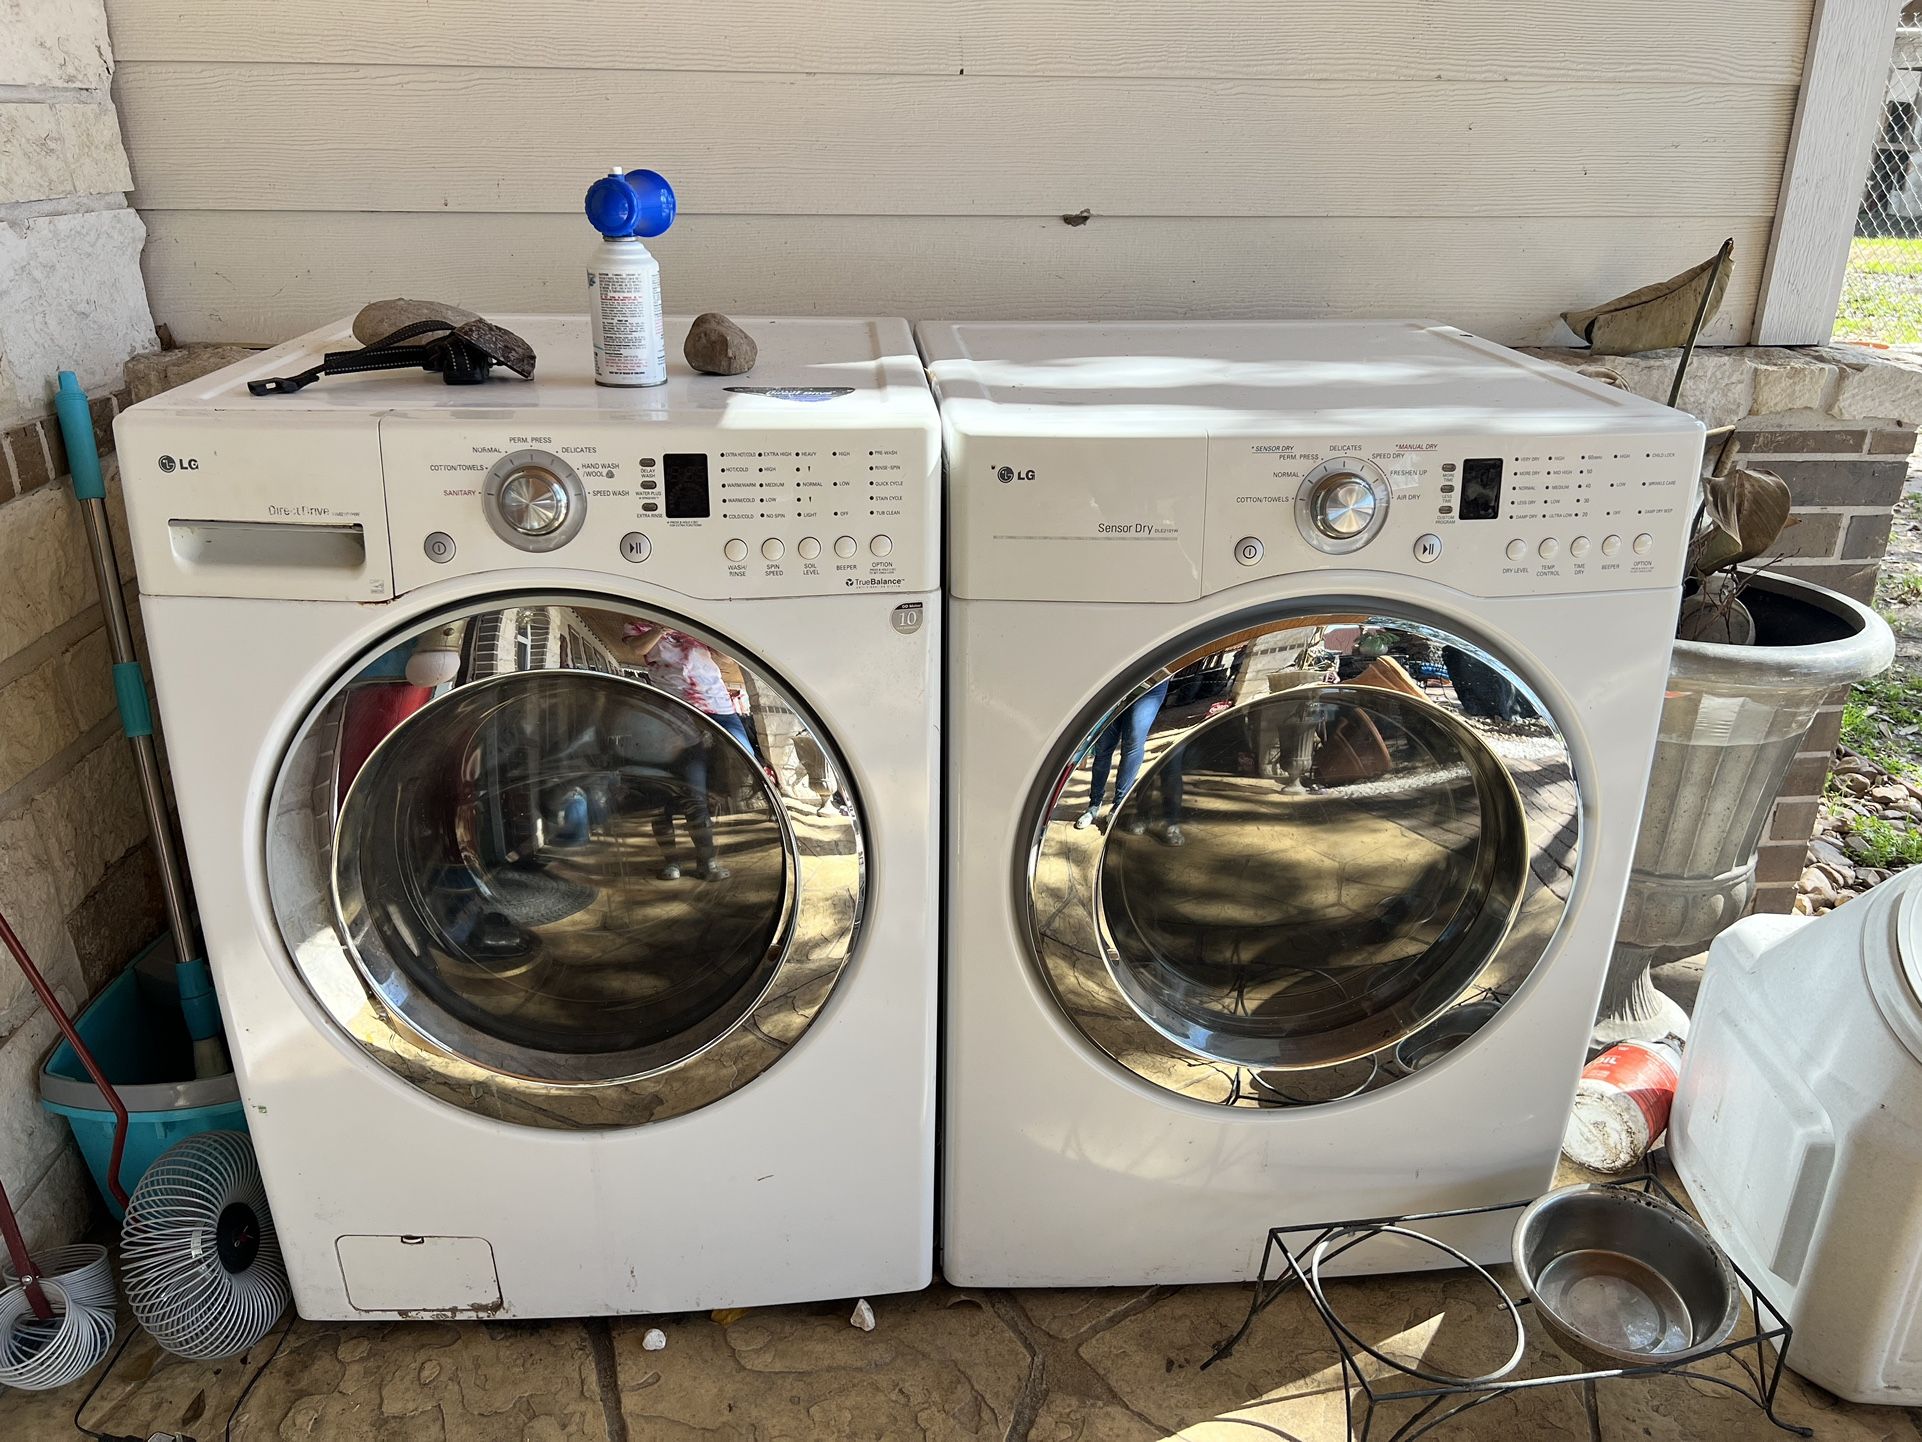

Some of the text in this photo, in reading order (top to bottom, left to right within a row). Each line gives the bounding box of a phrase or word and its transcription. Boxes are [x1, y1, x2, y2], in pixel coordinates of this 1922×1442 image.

[180, 458, 198, 470] LG
[1018, 470, 1035, 481] LG
[1098, 523, 1132, 533] Sensor
[1135, 523, 1153, 535] Dry
[899, 612, 916, 626] 10
